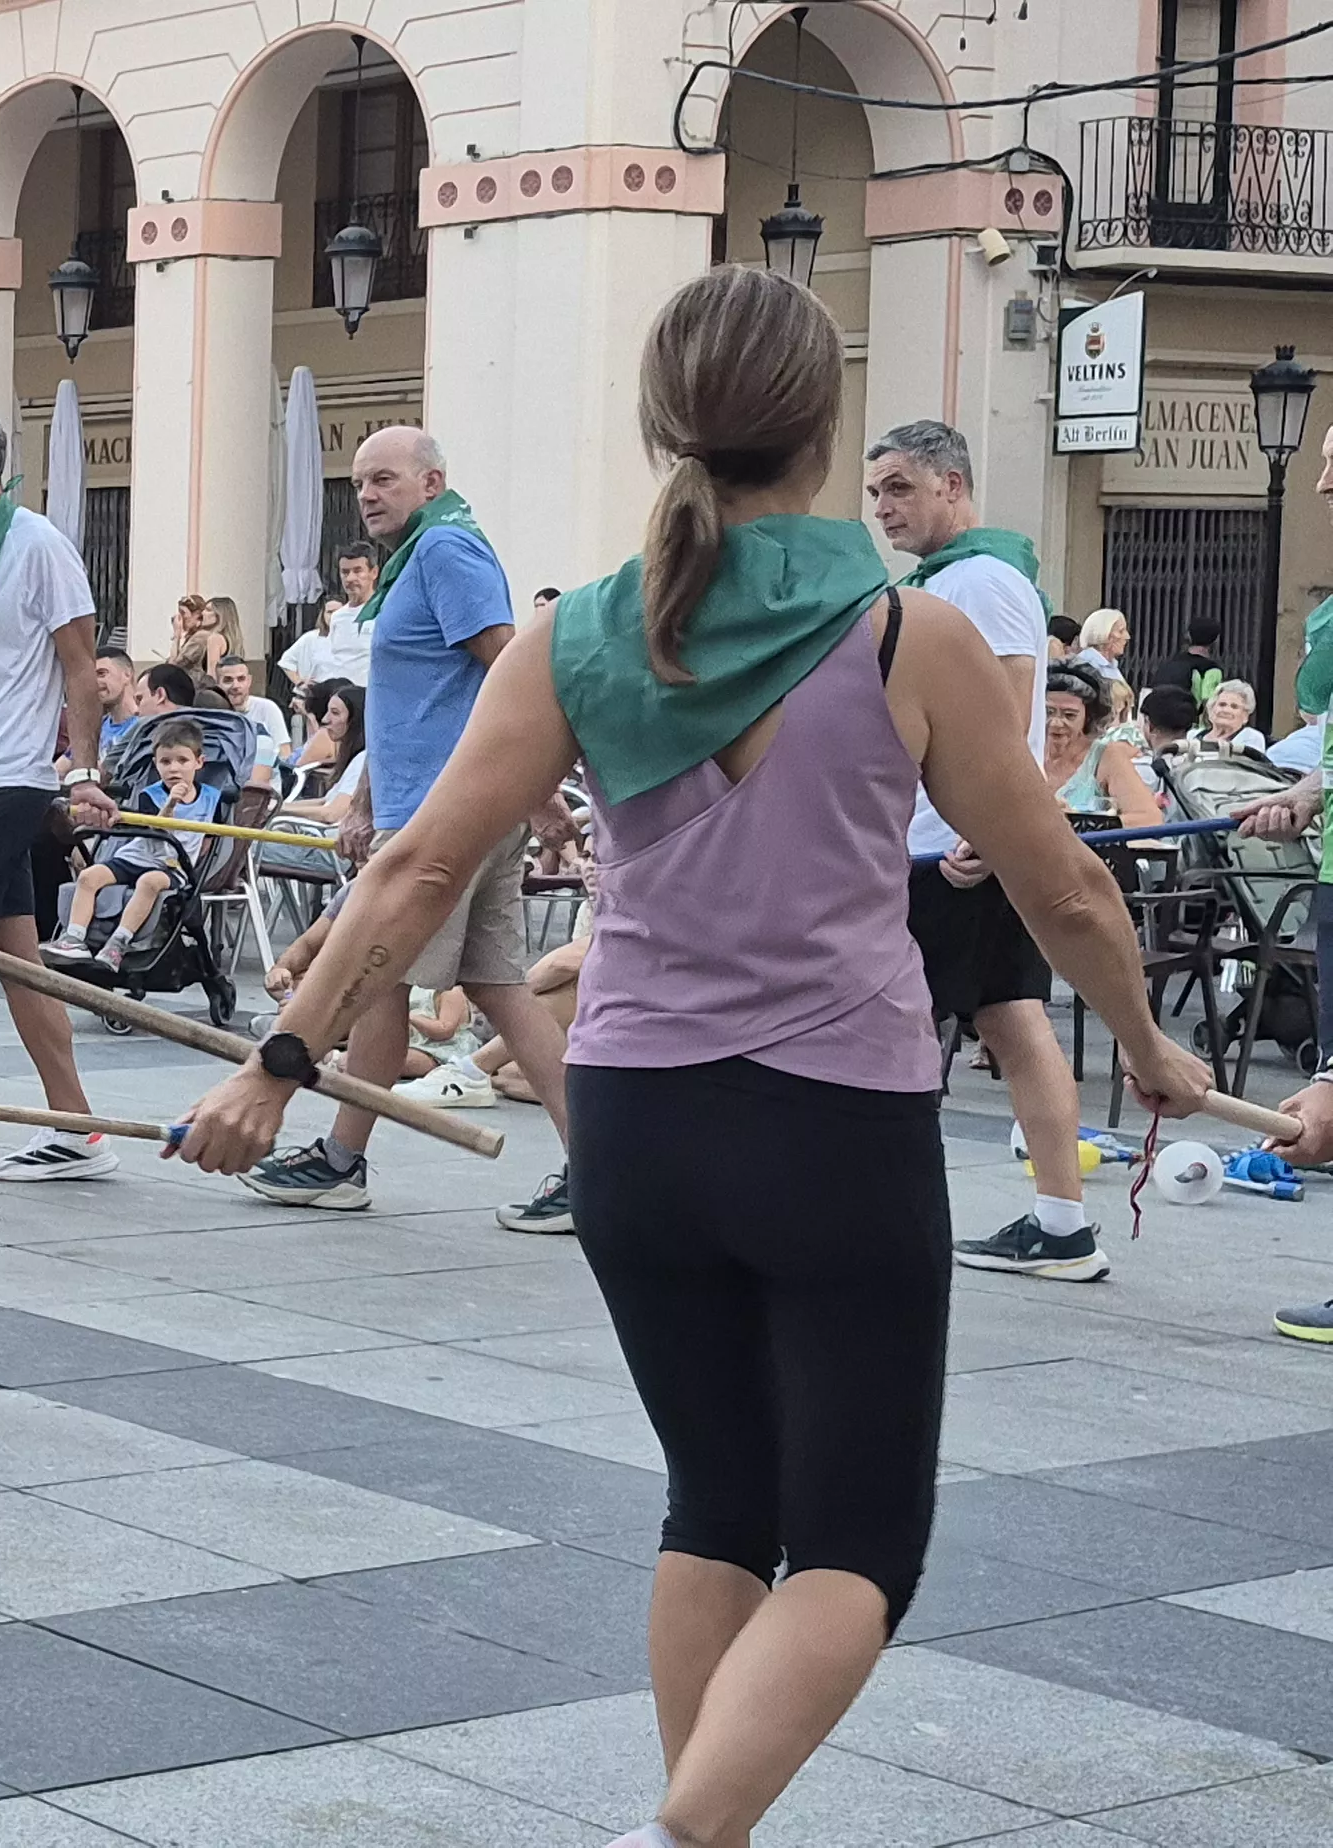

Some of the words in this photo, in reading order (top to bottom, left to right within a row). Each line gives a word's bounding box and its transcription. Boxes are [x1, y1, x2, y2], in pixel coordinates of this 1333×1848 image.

[1067, 363, 1126, 382] VELTINS
[1061, 426, 1079, 444] Alt
[1084, 423, 1128, 442] Berlin
[1186, 439, 1251, 470] JUAN
